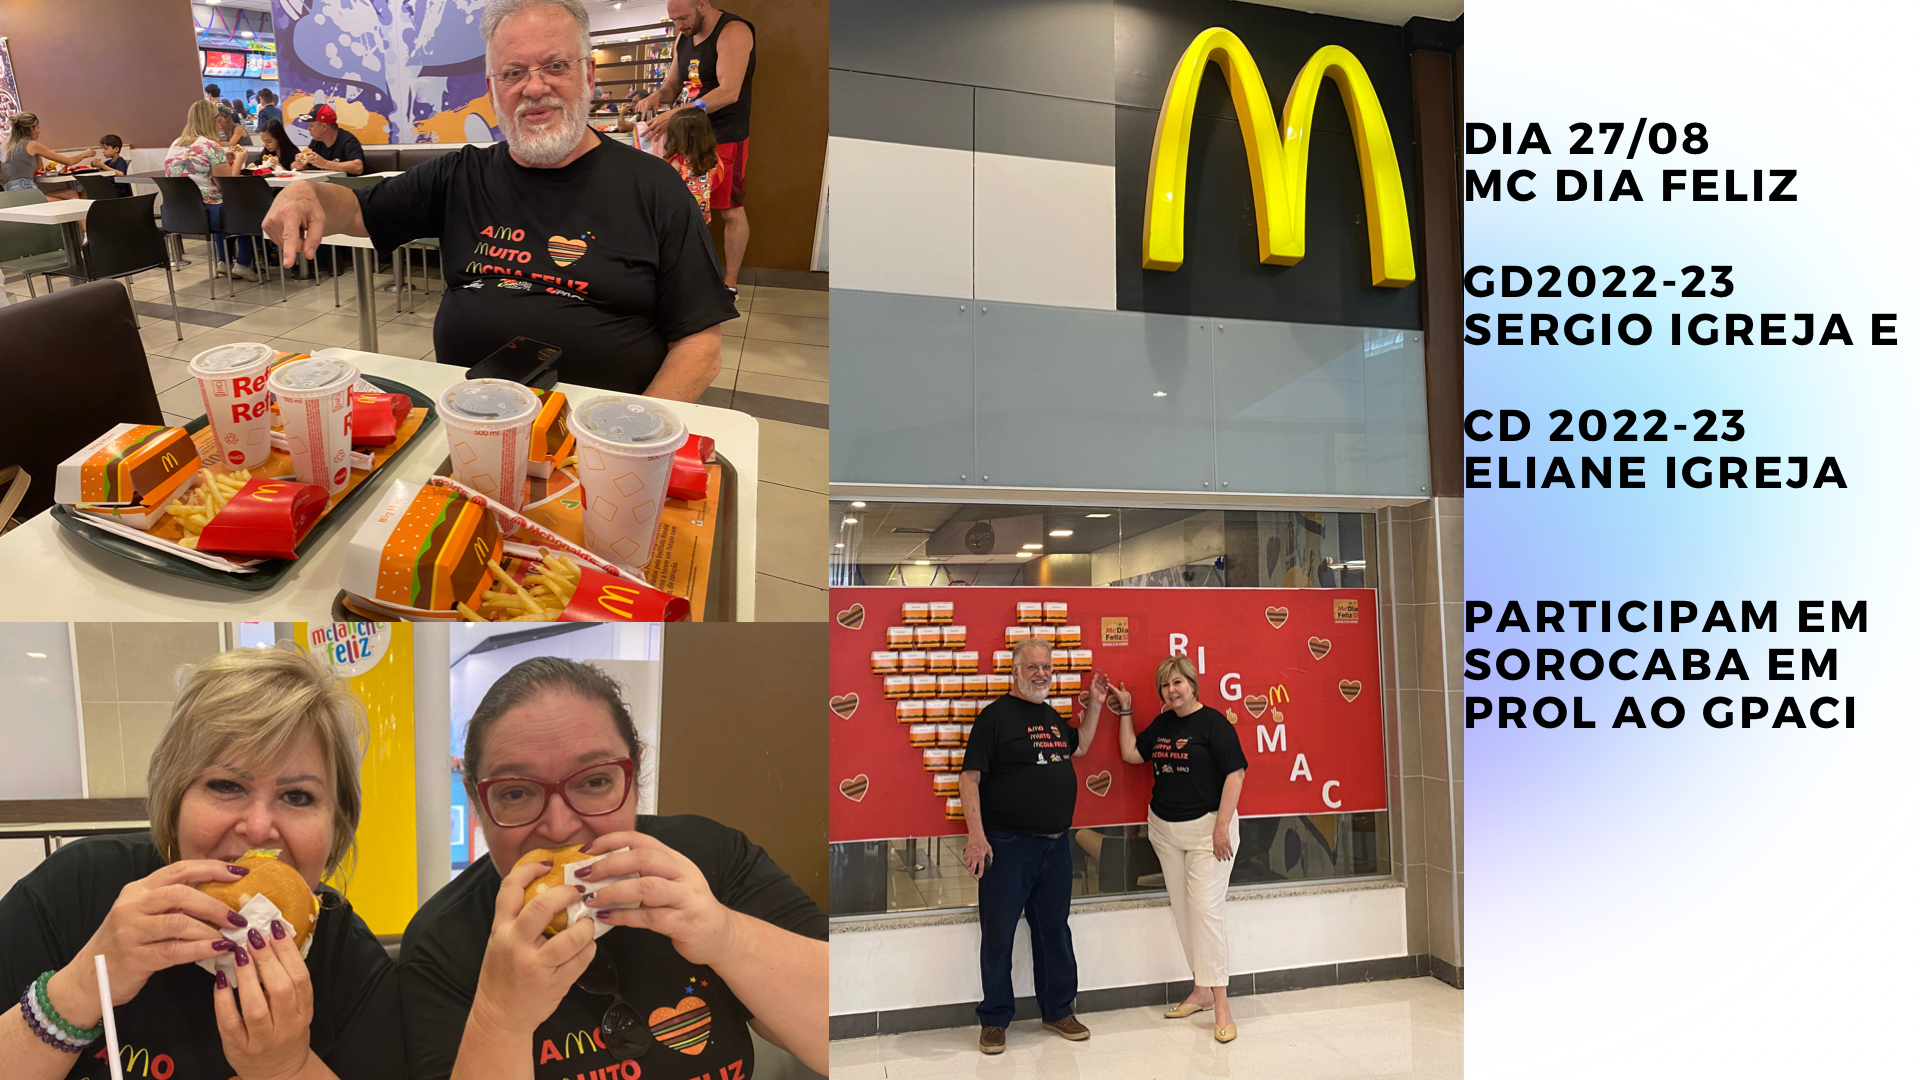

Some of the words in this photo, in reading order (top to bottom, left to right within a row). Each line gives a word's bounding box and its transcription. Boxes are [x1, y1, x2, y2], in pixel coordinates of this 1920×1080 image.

[480, 226, 525, 242] AMO
[474, 242, 532, 264] MUITO
[528, 524, 600, 565] McDonald's
[326, 634, 372, 666] feliz
